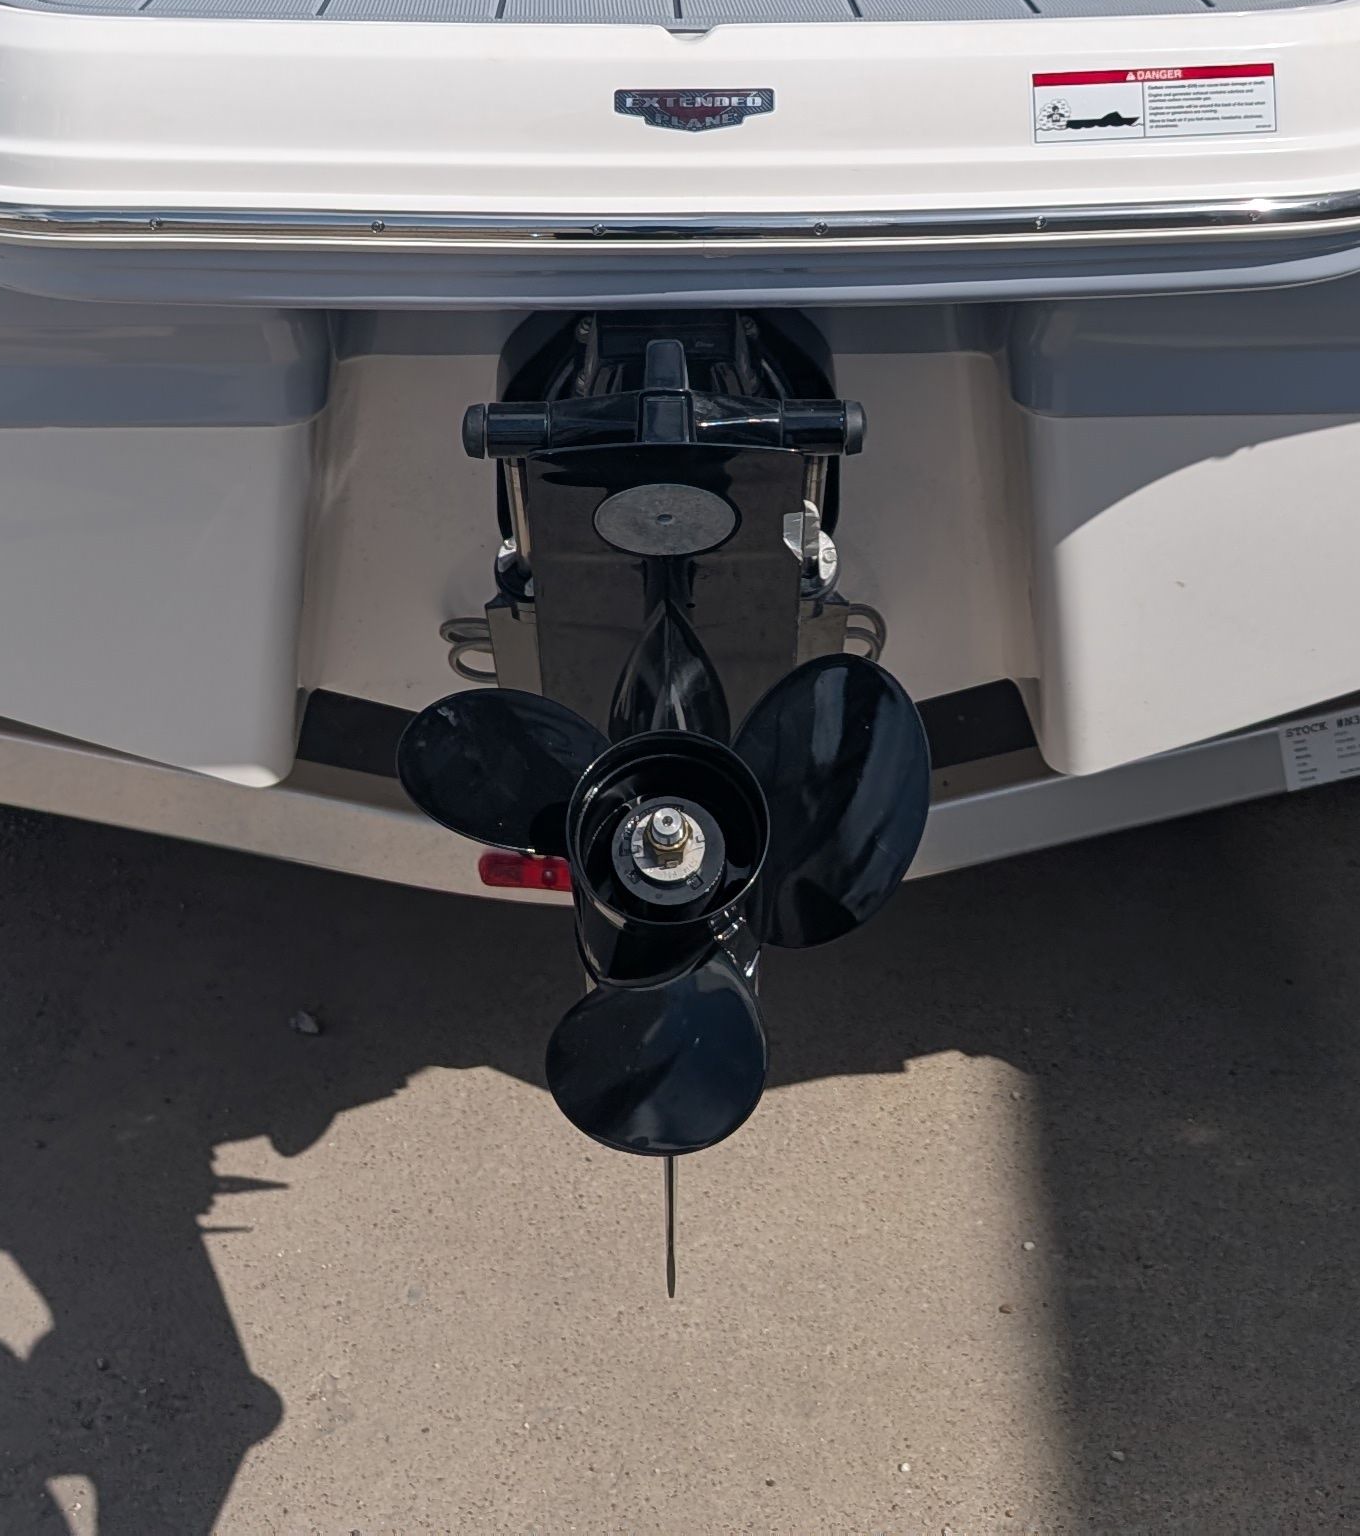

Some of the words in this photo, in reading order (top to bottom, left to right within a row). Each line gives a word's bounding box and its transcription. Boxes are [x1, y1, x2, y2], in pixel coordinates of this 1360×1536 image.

[1137, 70, 1182, 81] DANGER
[625, 96, 763, 108] EXTENDED
[654, 113, 737, 128] PLANE
[1285, 721, 1328, 738] STOCK
